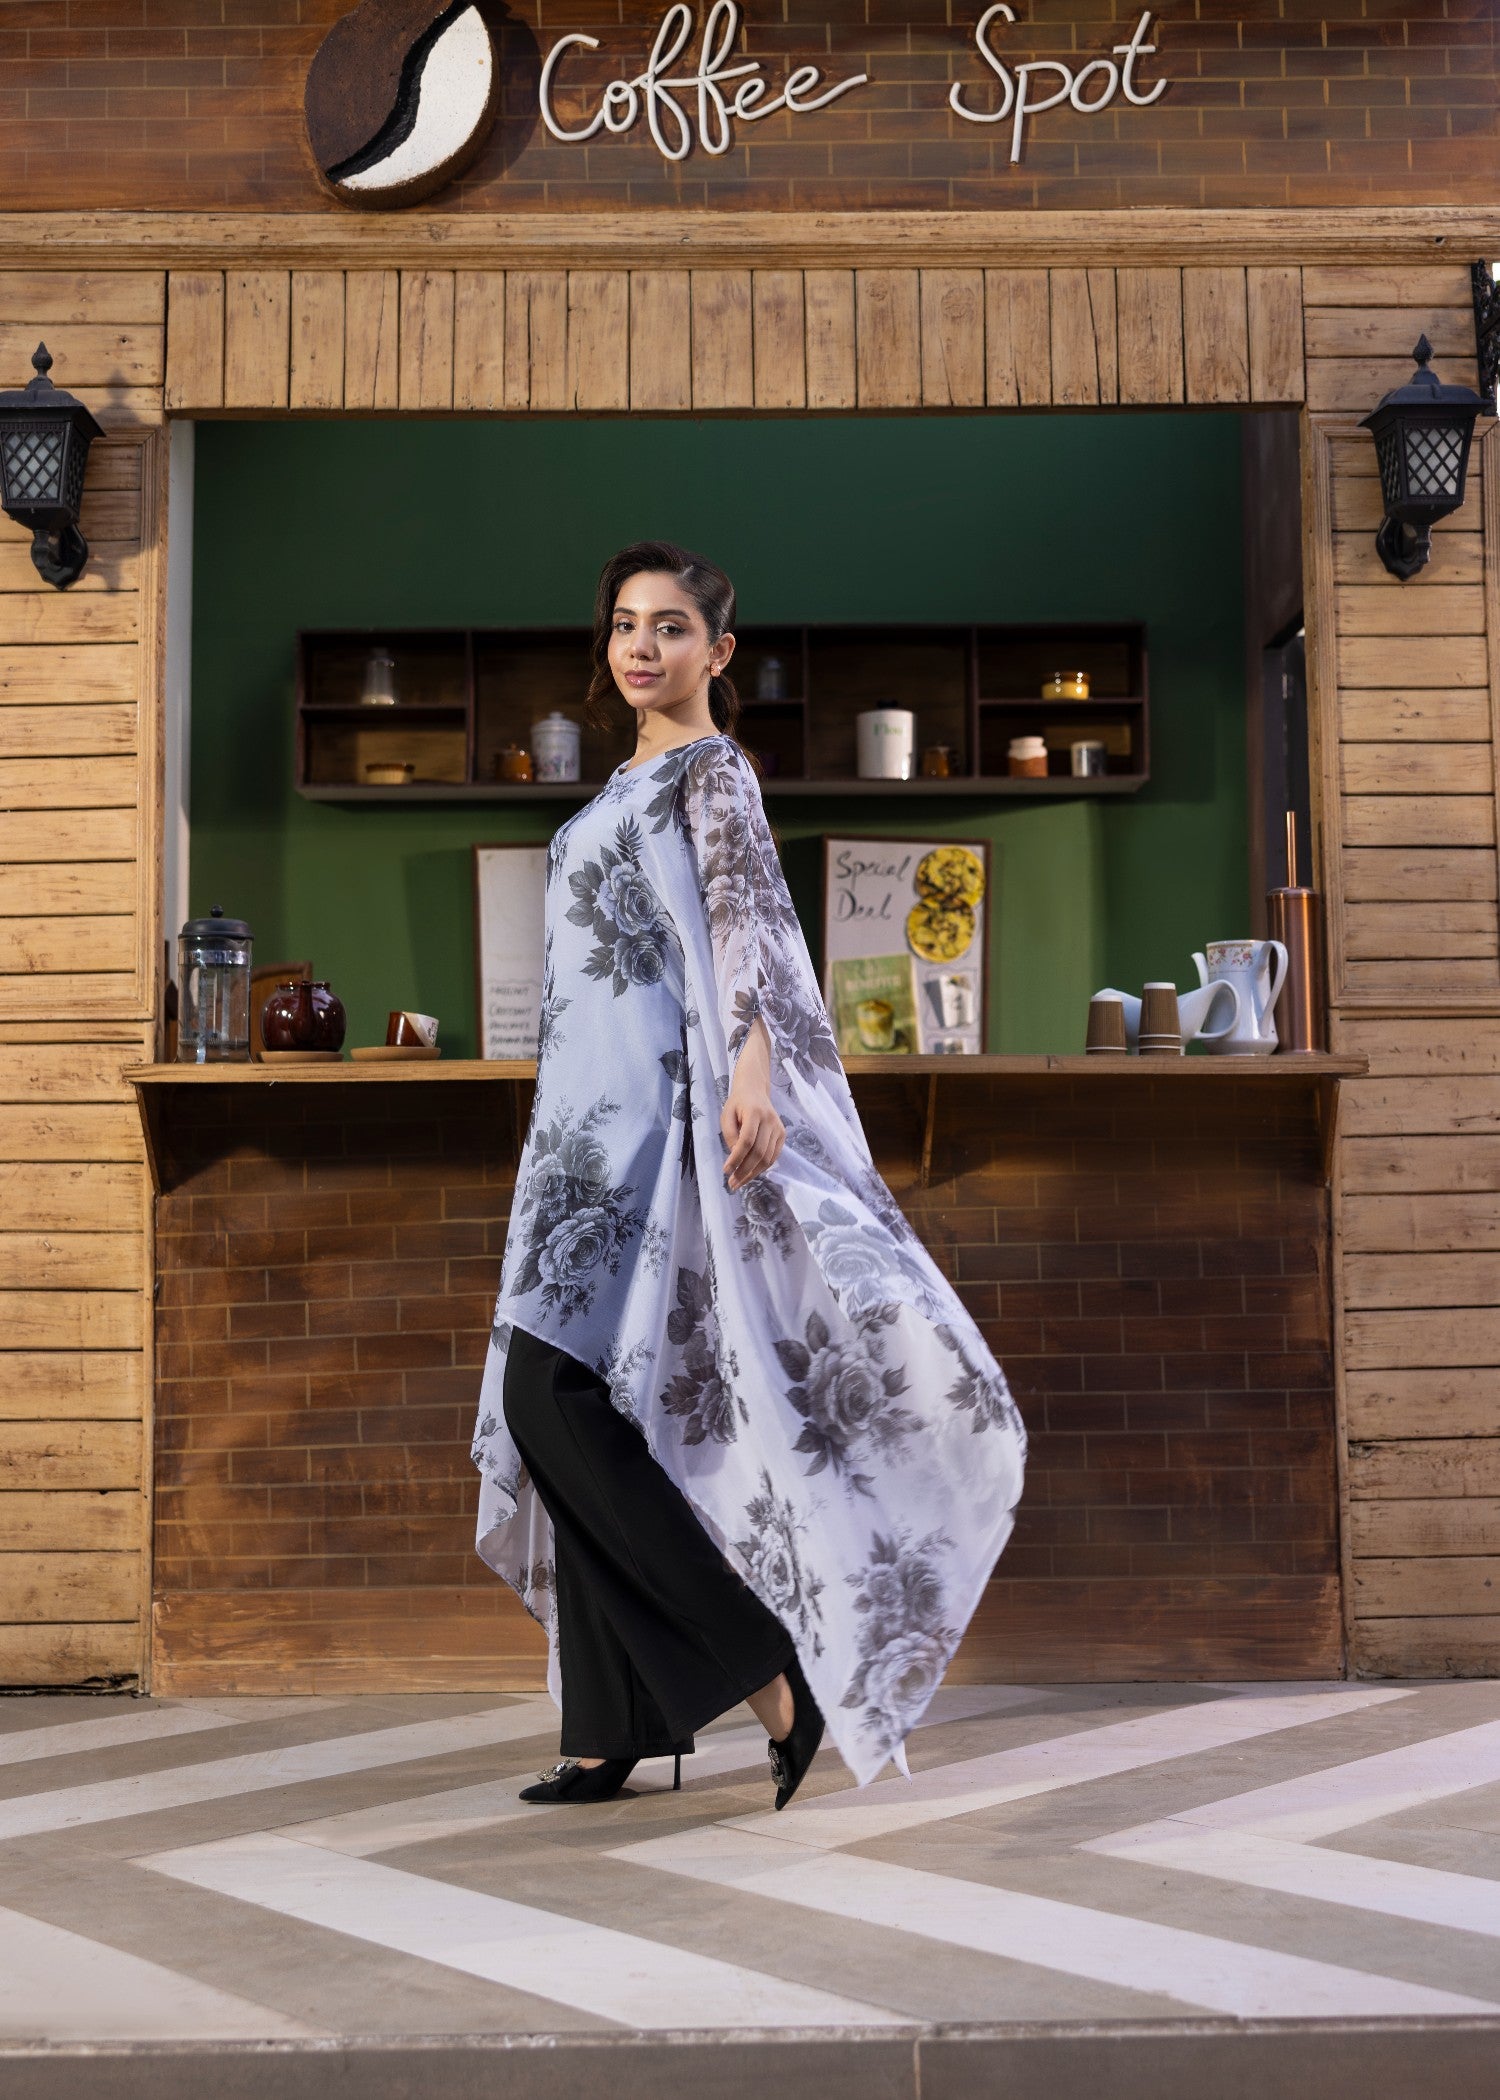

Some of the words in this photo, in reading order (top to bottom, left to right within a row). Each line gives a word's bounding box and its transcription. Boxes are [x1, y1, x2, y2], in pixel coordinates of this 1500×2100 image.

[540, 0, 867, 160] Coffee
[949, 4, 1167, 163] Spot
[836, 851, 911, 891] Special
[834, 888, 892, 922] Deal
